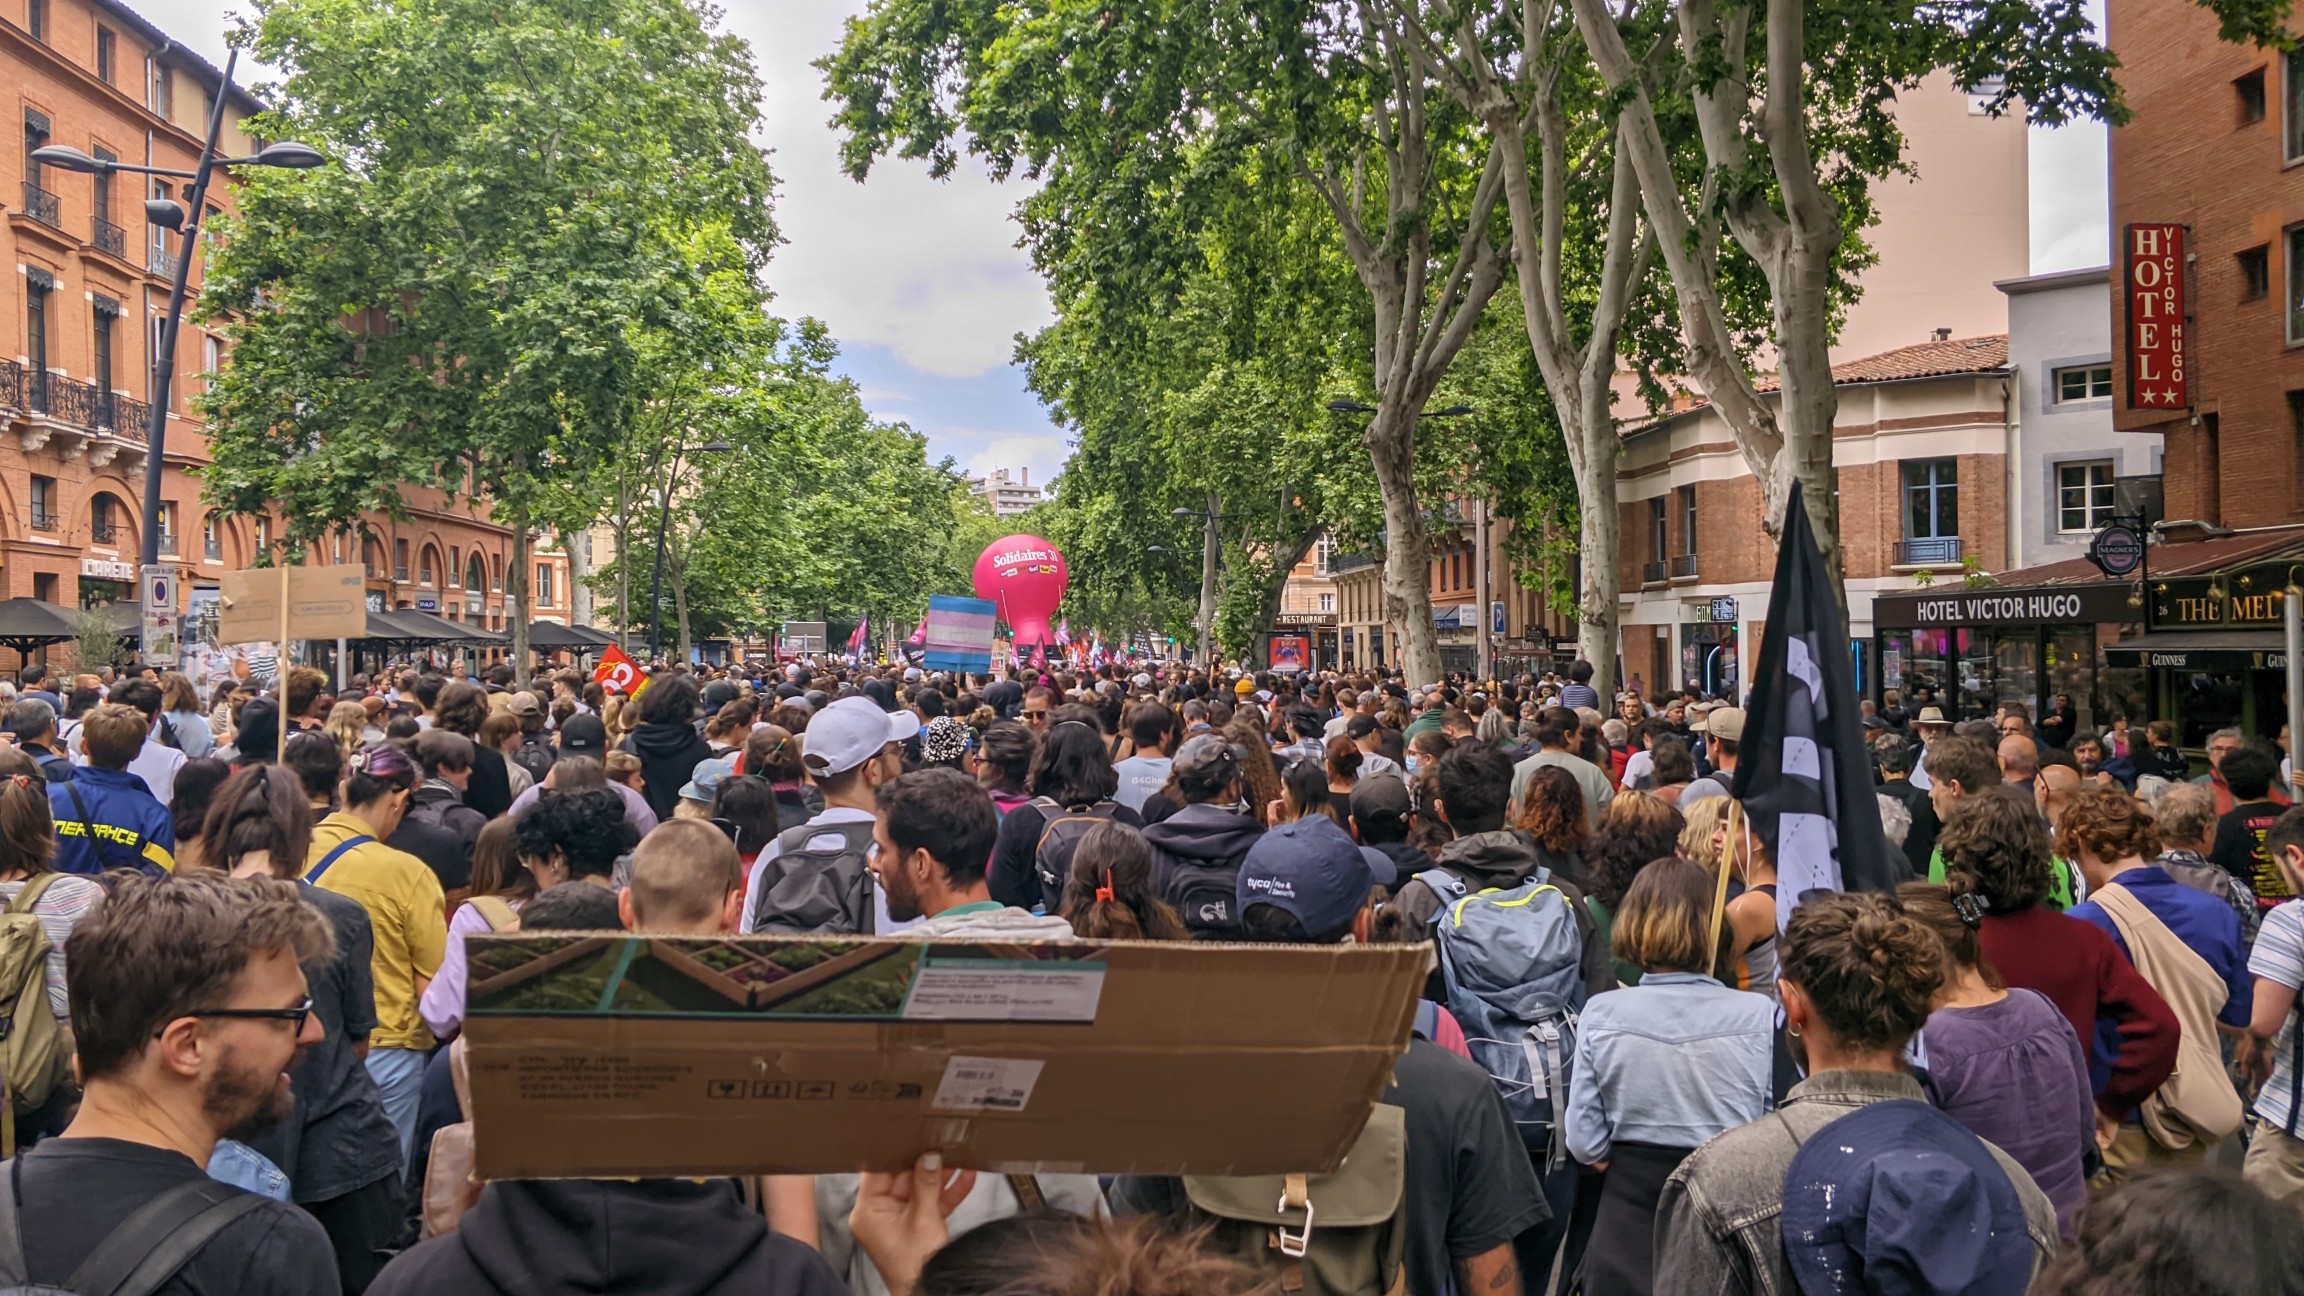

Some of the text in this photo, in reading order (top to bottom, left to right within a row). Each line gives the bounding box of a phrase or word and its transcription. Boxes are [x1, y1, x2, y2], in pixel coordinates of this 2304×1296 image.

[2134, 229, 2161, 381] HOTEL
[2164, 227, 2184, 383] VICTOR HUGO
[993, 548, 1059, 569] Solidaires 31
[1917, 594, 2081, 622] HOTEL VICTOR HUGO
[2158, 604, 2168, 616] 26
[2176, 597, 2221, 622] THE
[1282, 615, 1327, 624] RESTAURANT
[2152, 653, 2186, 666] GUINNESS
[1247, 876, 1271, 890] tyco
